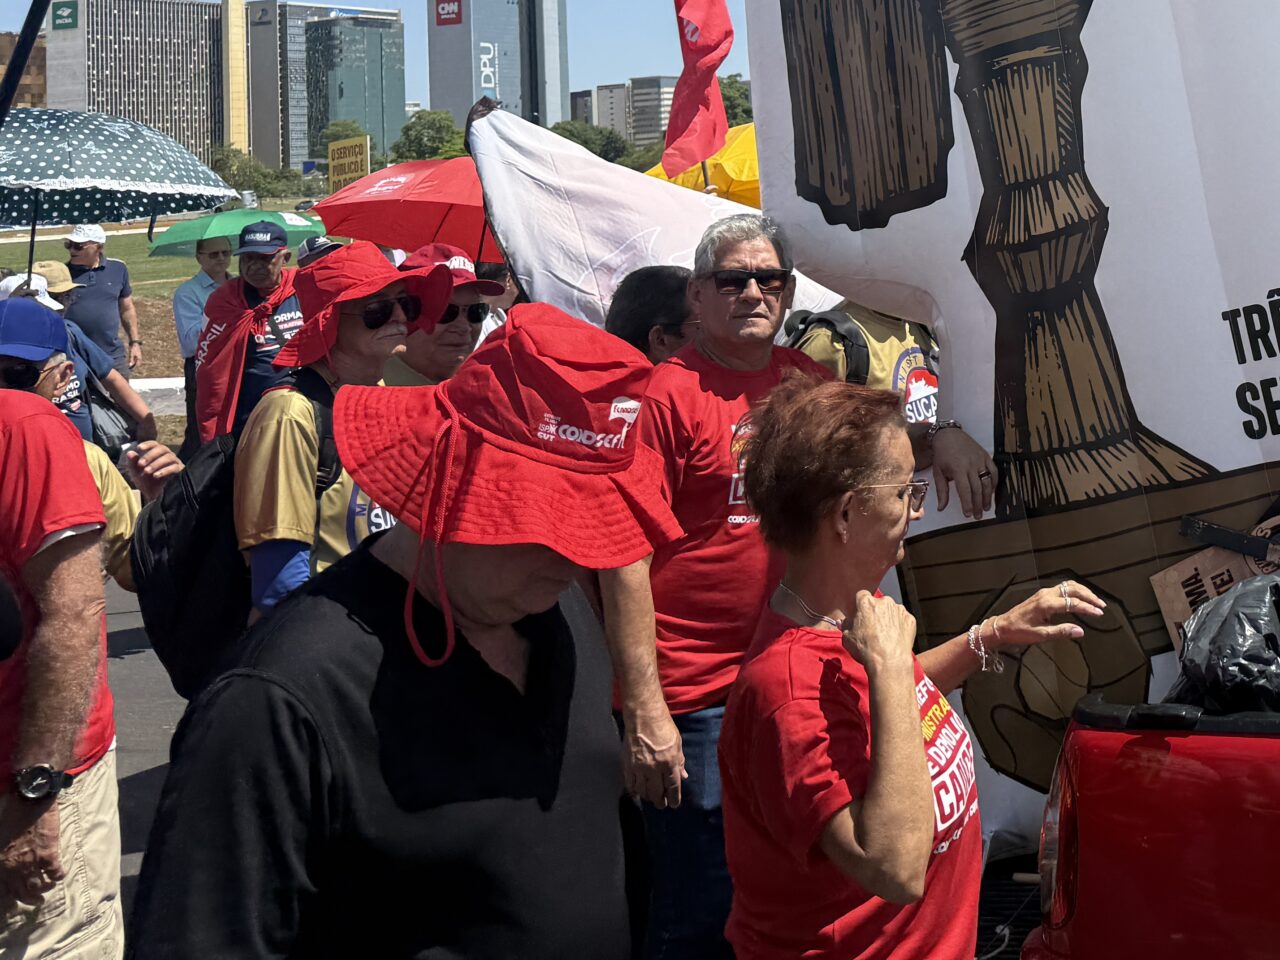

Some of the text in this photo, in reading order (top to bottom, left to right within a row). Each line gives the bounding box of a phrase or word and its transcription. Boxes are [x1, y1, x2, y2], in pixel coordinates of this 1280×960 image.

[438, 2, 459, 15] CNN
[480, 42, 495, 88] DPU
[336, 143, 364, 160] SERVIÇO
